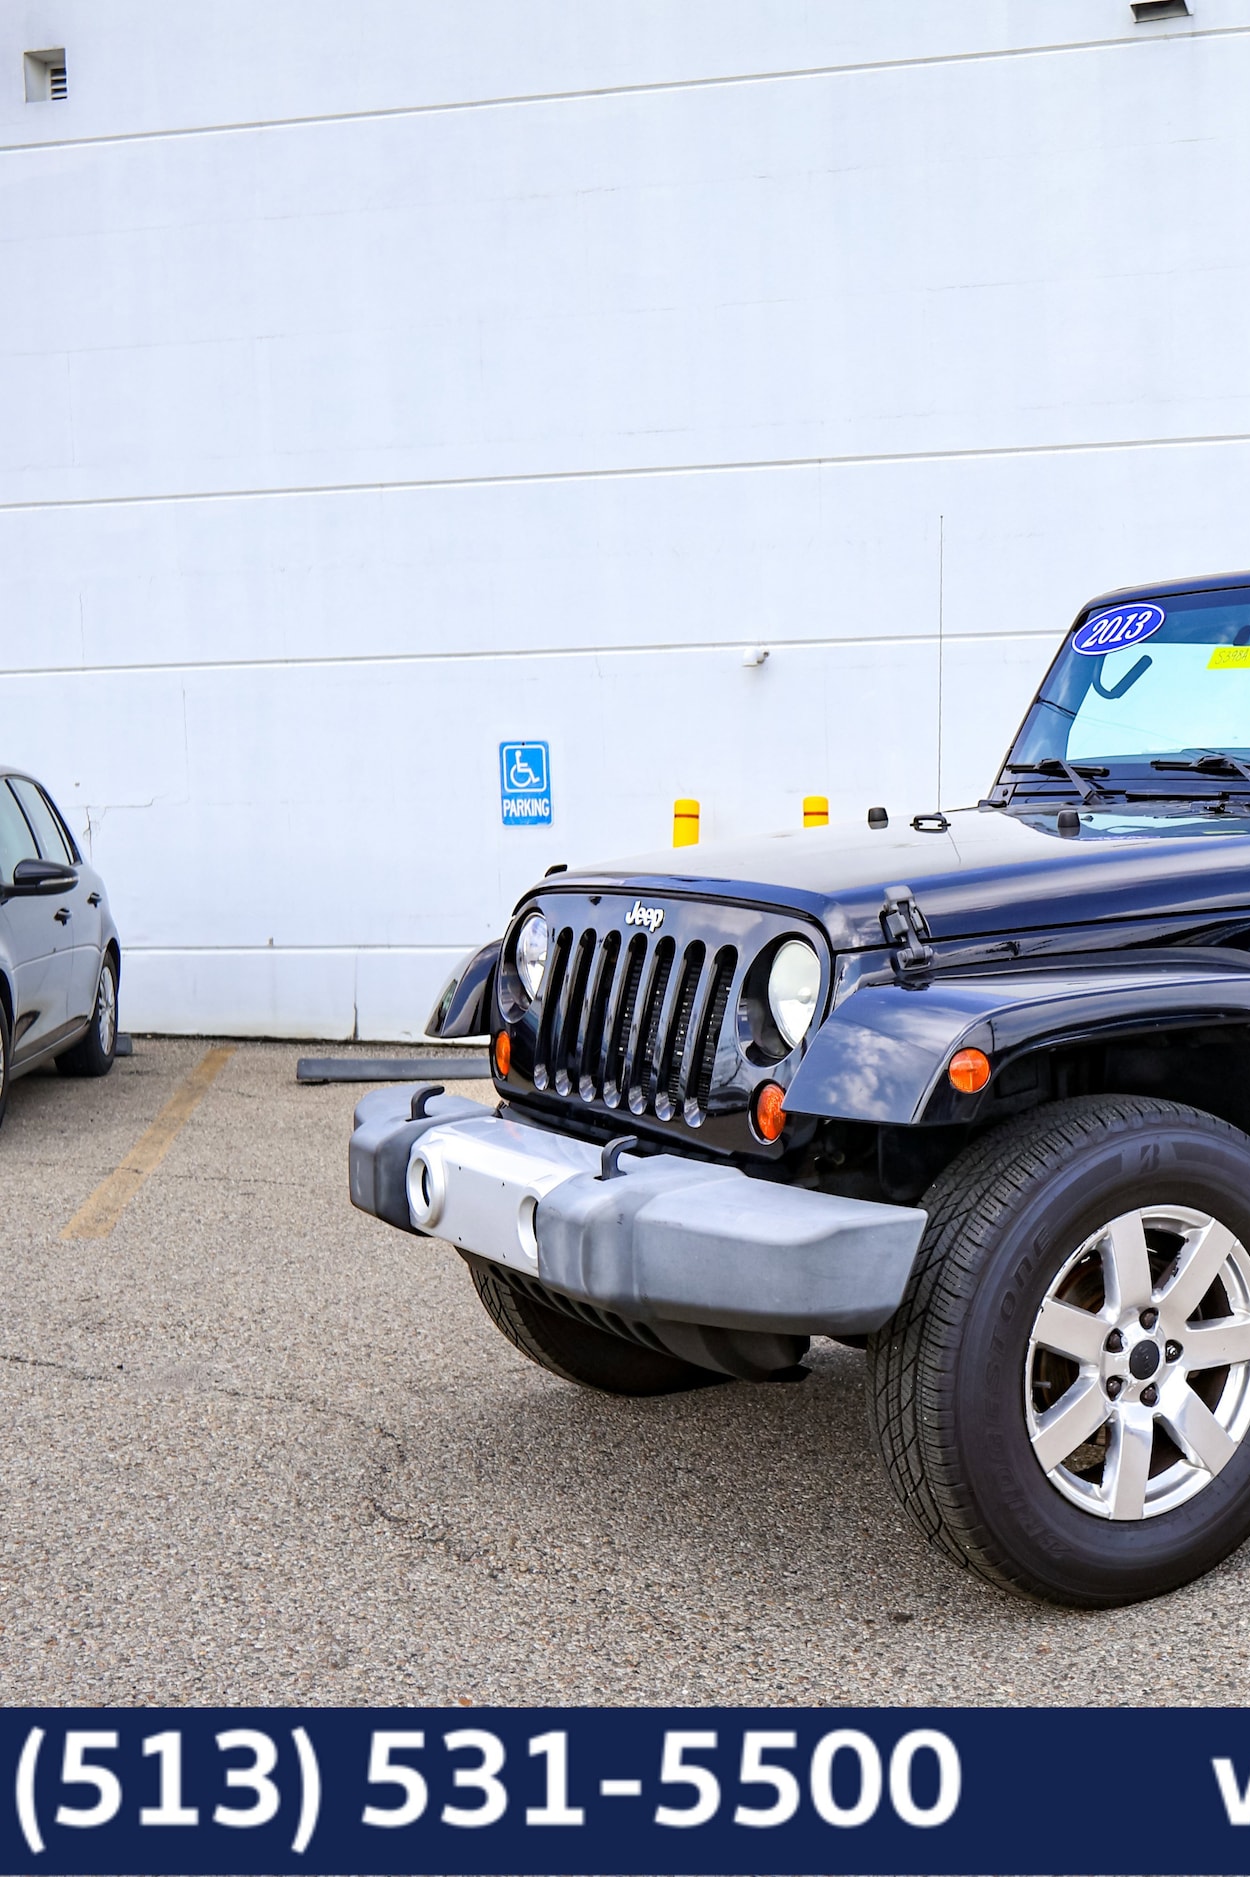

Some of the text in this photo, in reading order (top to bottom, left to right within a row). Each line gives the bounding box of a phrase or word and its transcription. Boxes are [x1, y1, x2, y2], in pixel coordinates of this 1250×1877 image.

[1081, 610, 1153, 649] 2013
[503, 798, 550, 817] PARKING
[625, 900, 664, 933] Jeep
